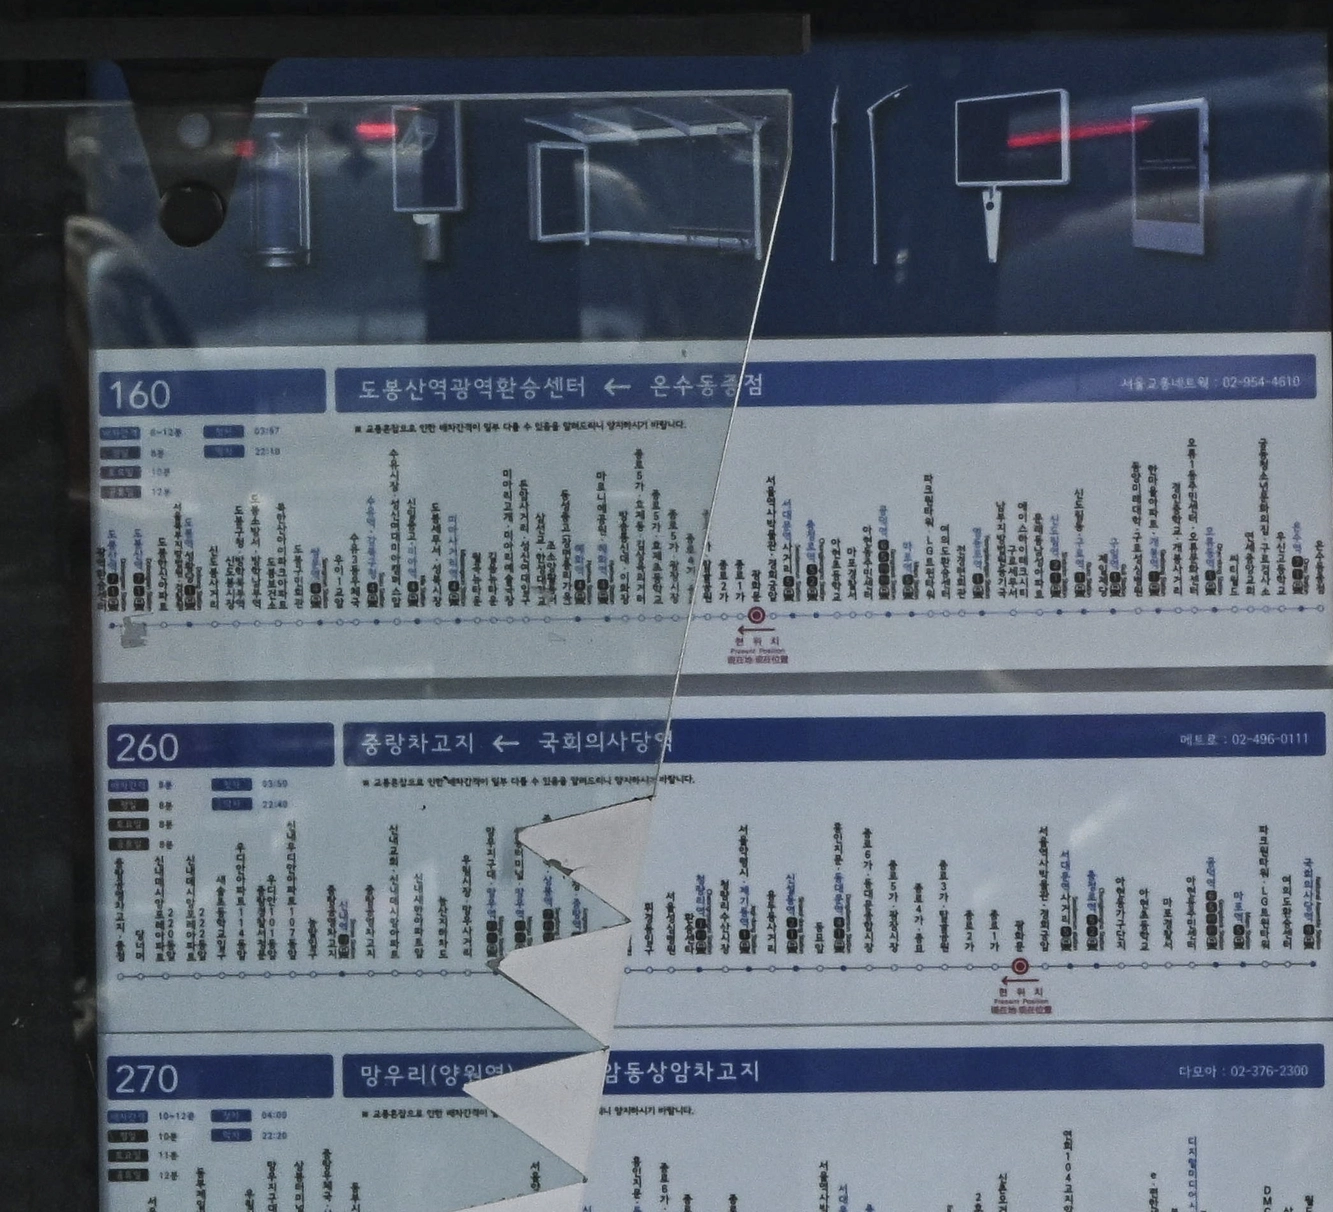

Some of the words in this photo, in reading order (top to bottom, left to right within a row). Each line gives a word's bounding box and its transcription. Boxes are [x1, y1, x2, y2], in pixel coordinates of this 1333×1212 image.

[109, 379, 171, 410] 160
[358, 374, 586, 403] 도봉산역광역환승센터
[649, 372, 764, 398] 온수동종점
[718, 559, 729, 603] 종로2가
[735, 559, 746, 603] 종로1가
[115, 732, 180, 763] 260
[361, 731, 476, 757] 중랑차고지
[1231, 732, 1309, 746] 02-496-0111
[887, 859, 899, 954] 종로5가·광장시장
[913, 882, 925, 953] 종로4가·종묘
[963, 909, 975, 952] 종로2가
[989, 909, 1000, 952] 종로1가
[114, 1064, 179, 1094] 270
[1178, 1065, 1217, 1079] 다모아
[1230, 1064, 1309, 1077] 02-376-2300
